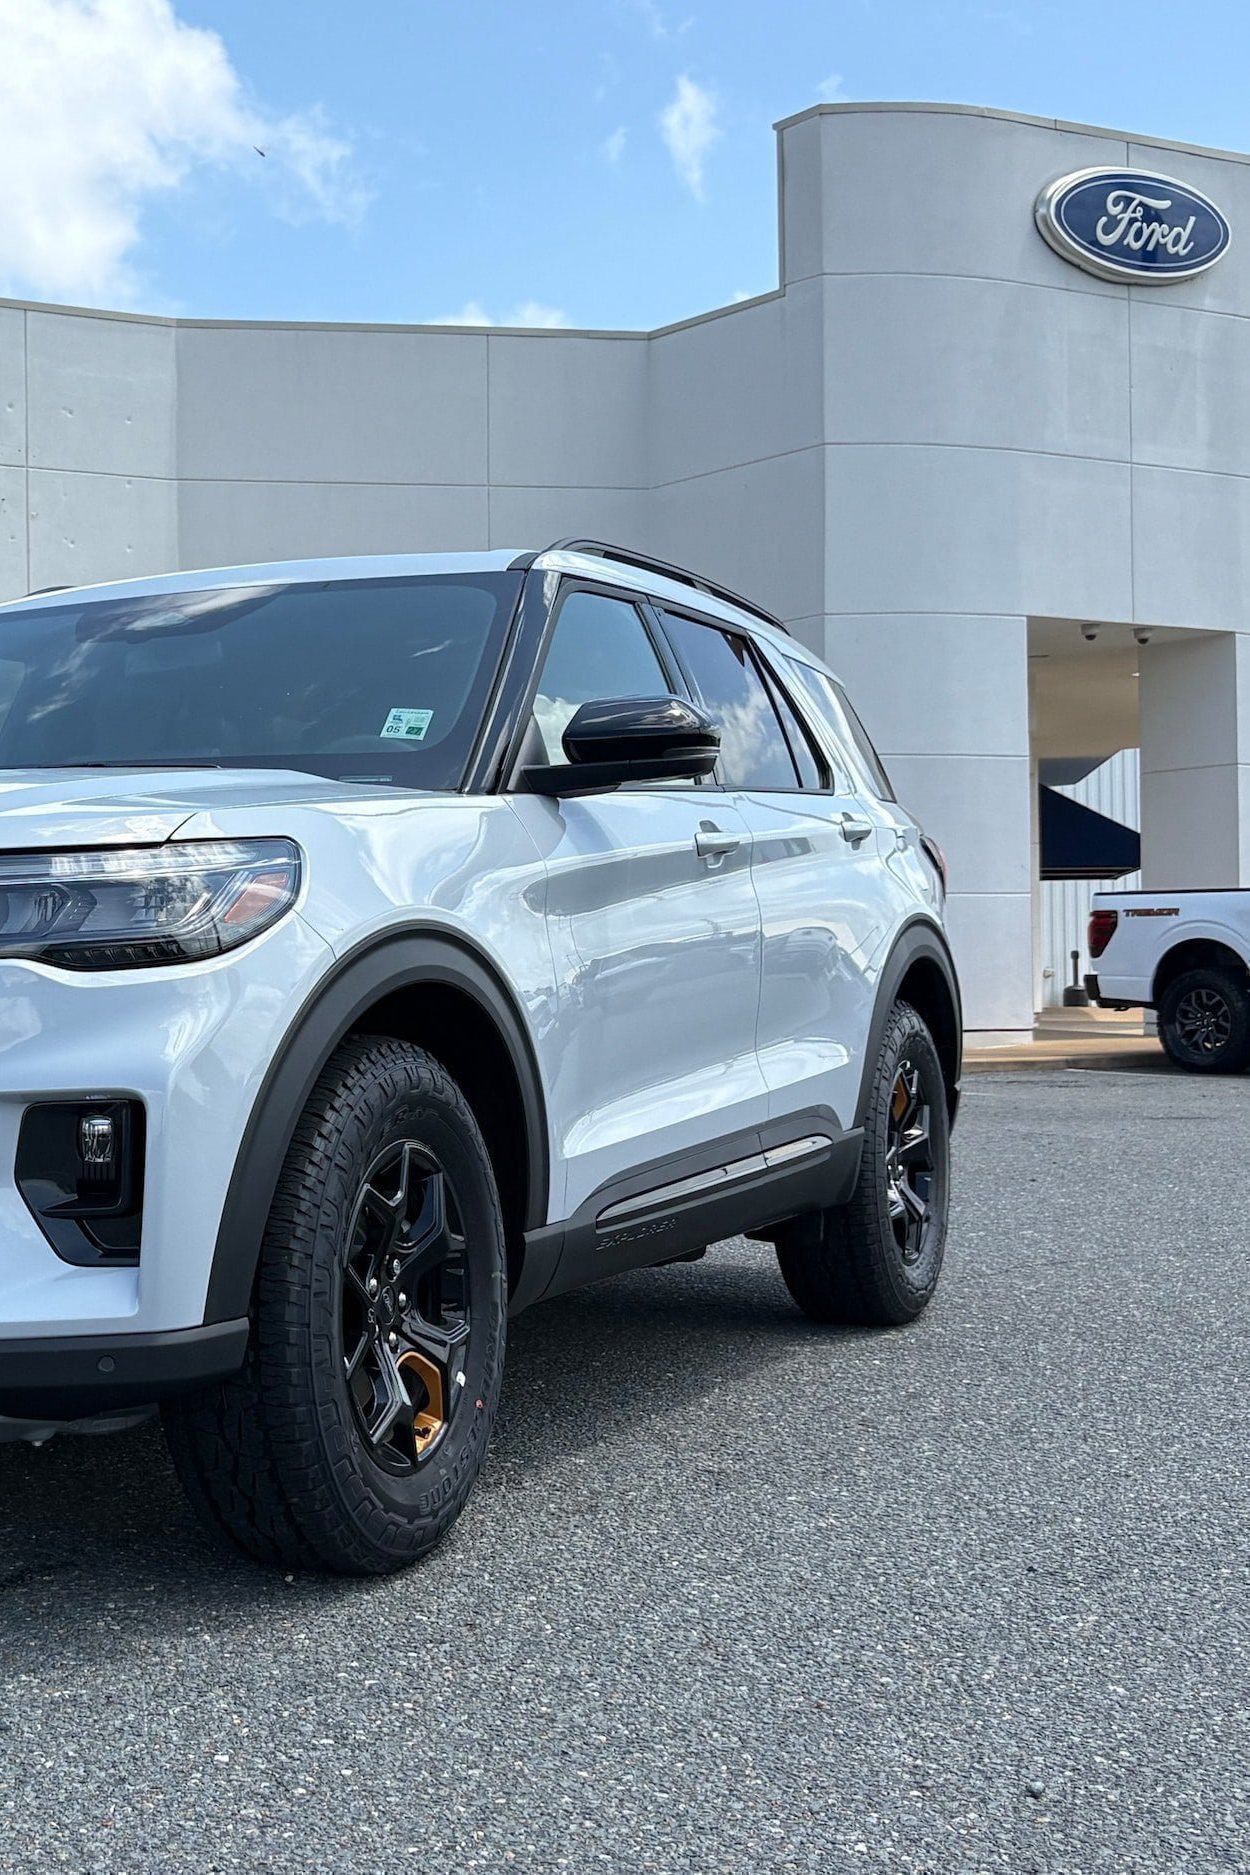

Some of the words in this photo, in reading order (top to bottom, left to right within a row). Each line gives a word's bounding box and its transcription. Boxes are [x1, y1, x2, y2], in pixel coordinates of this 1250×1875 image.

[1095, 189, 1197, 257] Ford
[386, 725, 401, 734] 05
[1122, 908, 1180, 917] TREMOR
